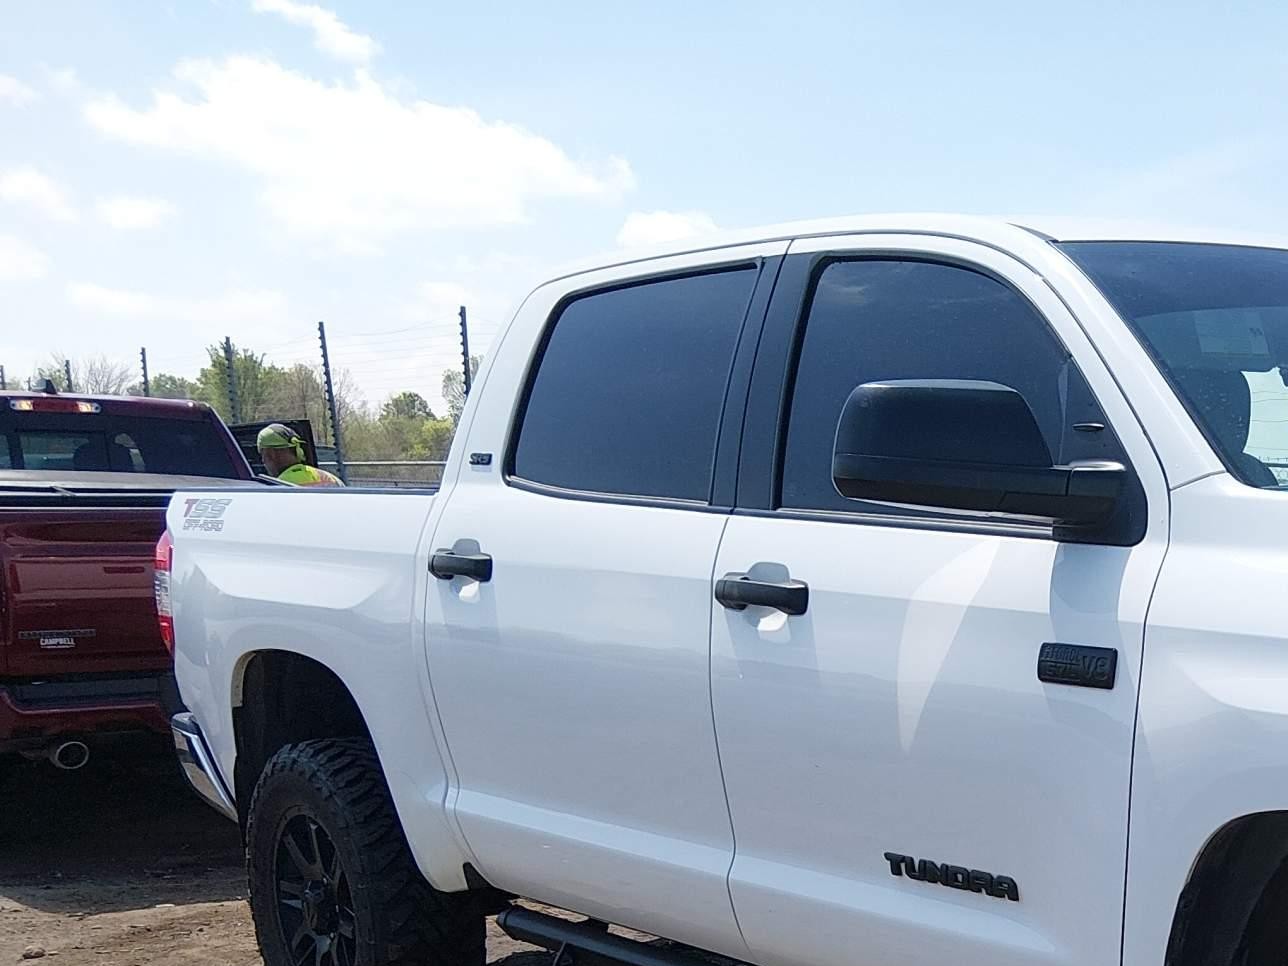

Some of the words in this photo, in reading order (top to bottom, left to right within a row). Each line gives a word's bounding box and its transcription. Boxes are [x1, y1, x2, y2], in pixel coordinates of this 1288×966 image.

[183, 499, 233, 518] TSS
[40, 637, 76, 646] CAMPBELL
[1082, 655, 1109, 682] V8
[884, 852, 1020, 902] TUNDRA
